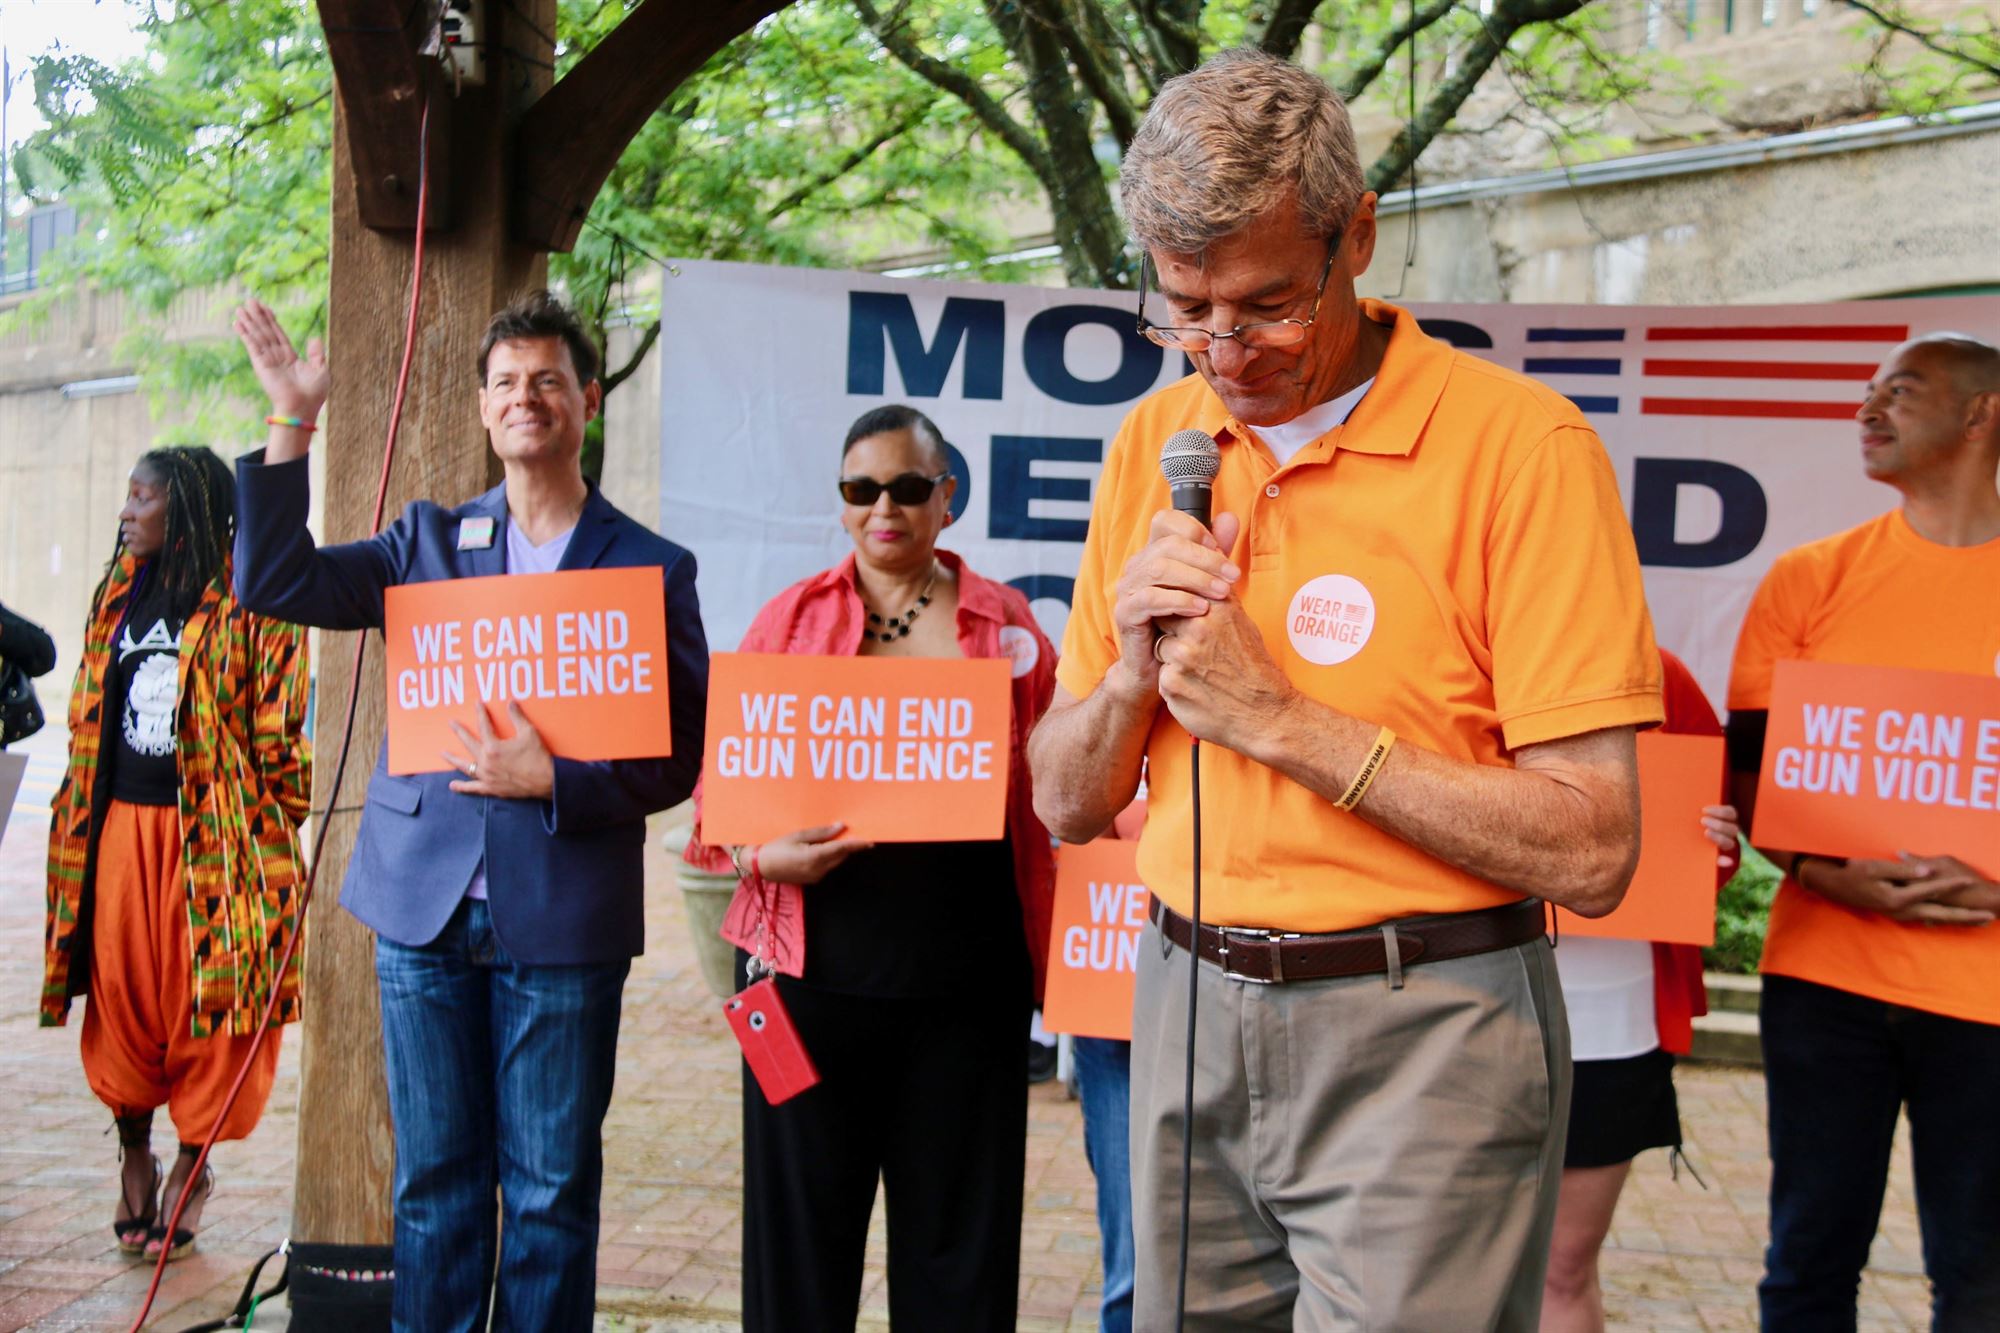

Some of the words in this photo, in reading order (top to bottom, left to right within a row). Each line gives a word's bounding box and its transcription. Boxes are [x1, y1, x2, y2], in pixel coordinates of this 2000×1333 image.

[1294, 614, 1362, 645] ORANGE
[1301, 595, 1342, 618] WEAR
[412, 620, 463, 664] WE
[472, 614, 543, 659] CAN
[556, 610, 629, 653] END
[397, 664, 465, 710] GUN
[474, 652, 653, 702] VIOLENCE
[740, 692, 798, 734] WE
[809, 695, 886, 737] CAN
[898, 697, 973, 738] END
[1803, 703, 1866, 750] WE
[1875, 710, 1964, 759] CAN
[717, 735, 796, 779] GUN
[808, 738, 993, 782] VIOLENCE
[1774, 746, 1861, 796] GUN
[1873, 756, 2000, 810] VIOLE
[1088, 881, 1147, 927] WE
[1063, 925, 1141, 974] GUN
